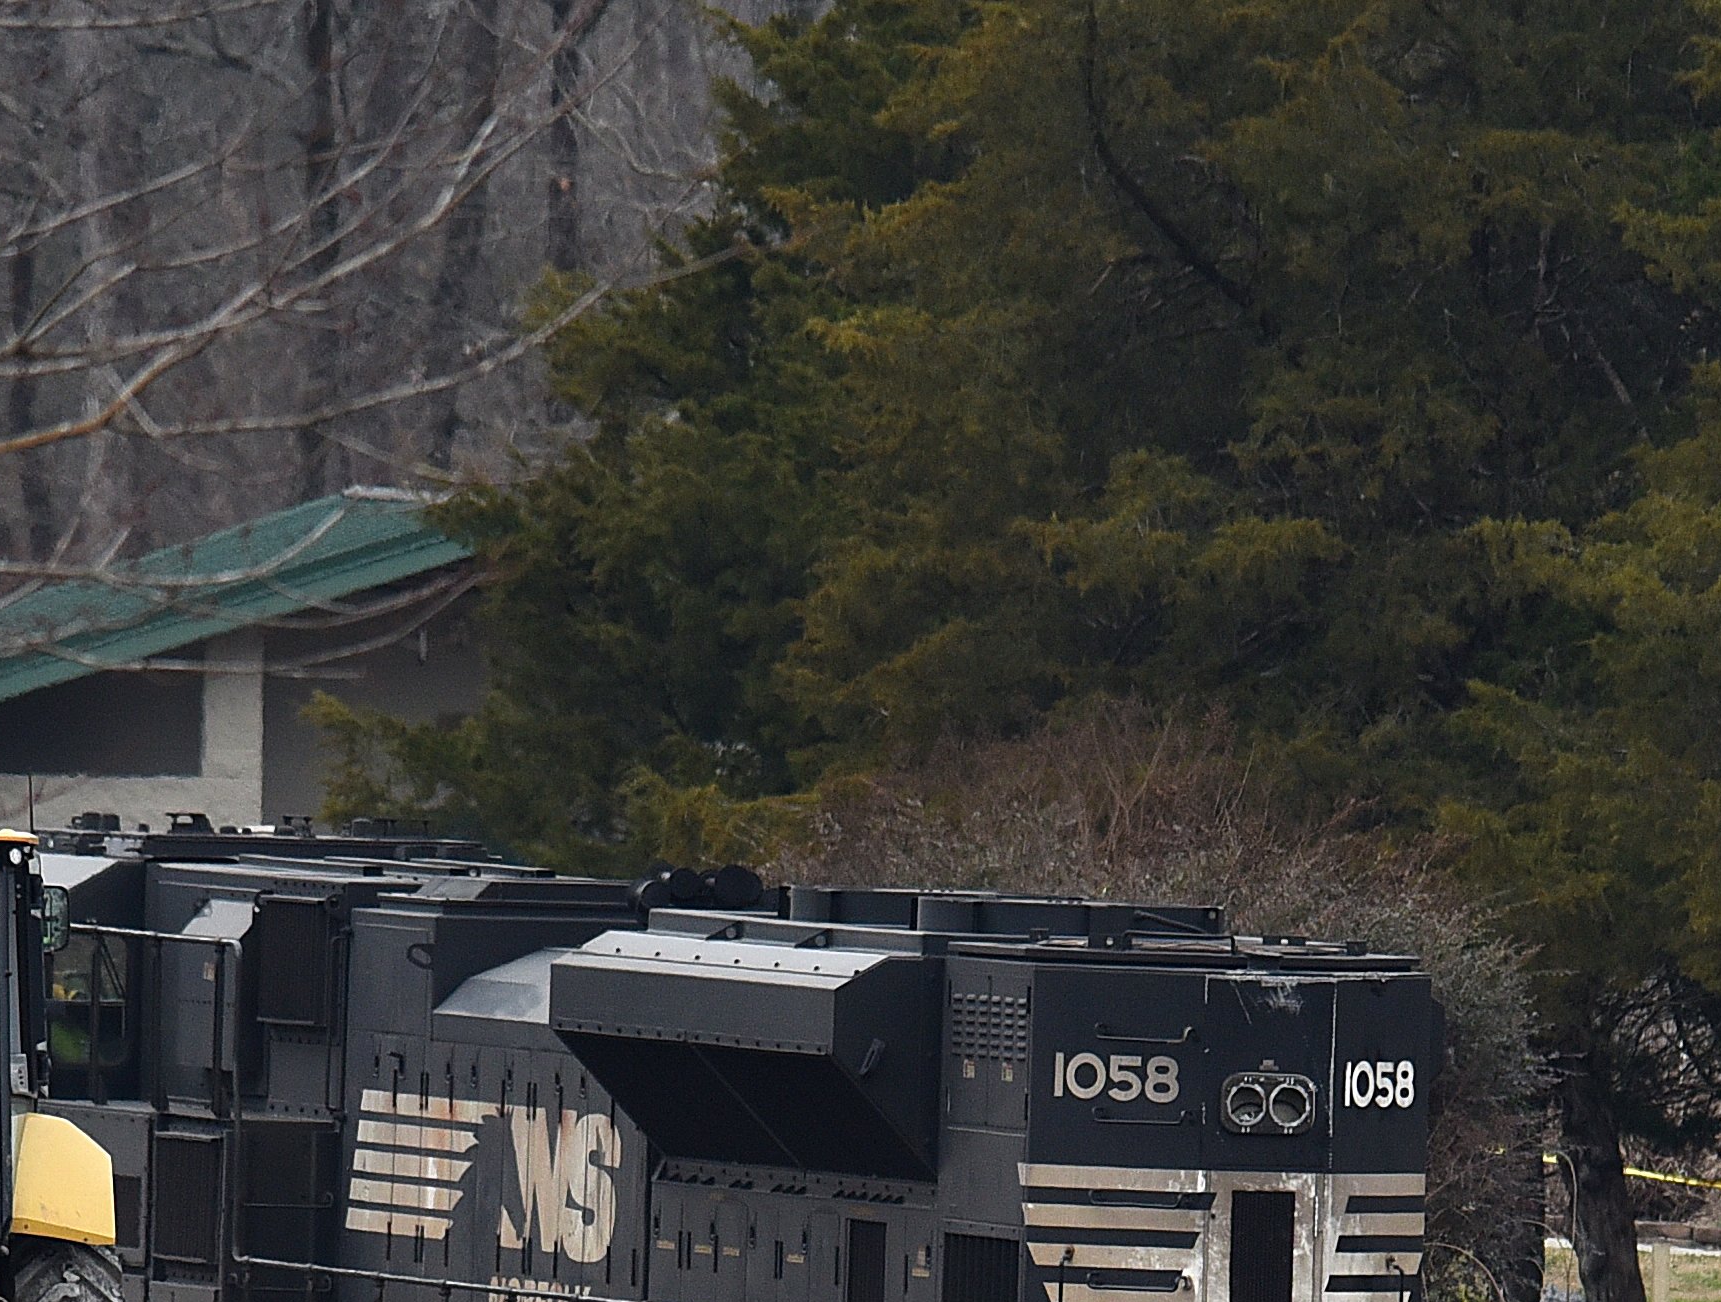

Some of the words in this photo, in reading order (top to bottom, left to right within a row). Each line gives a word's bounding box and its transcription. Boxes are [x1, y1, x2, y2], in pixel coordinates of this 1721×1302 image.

[1053, 1051, 1180, 1104] 1058
[1344, 1060, 1415, 1109] 1058
[498, 1105, 622, 1264] NS
